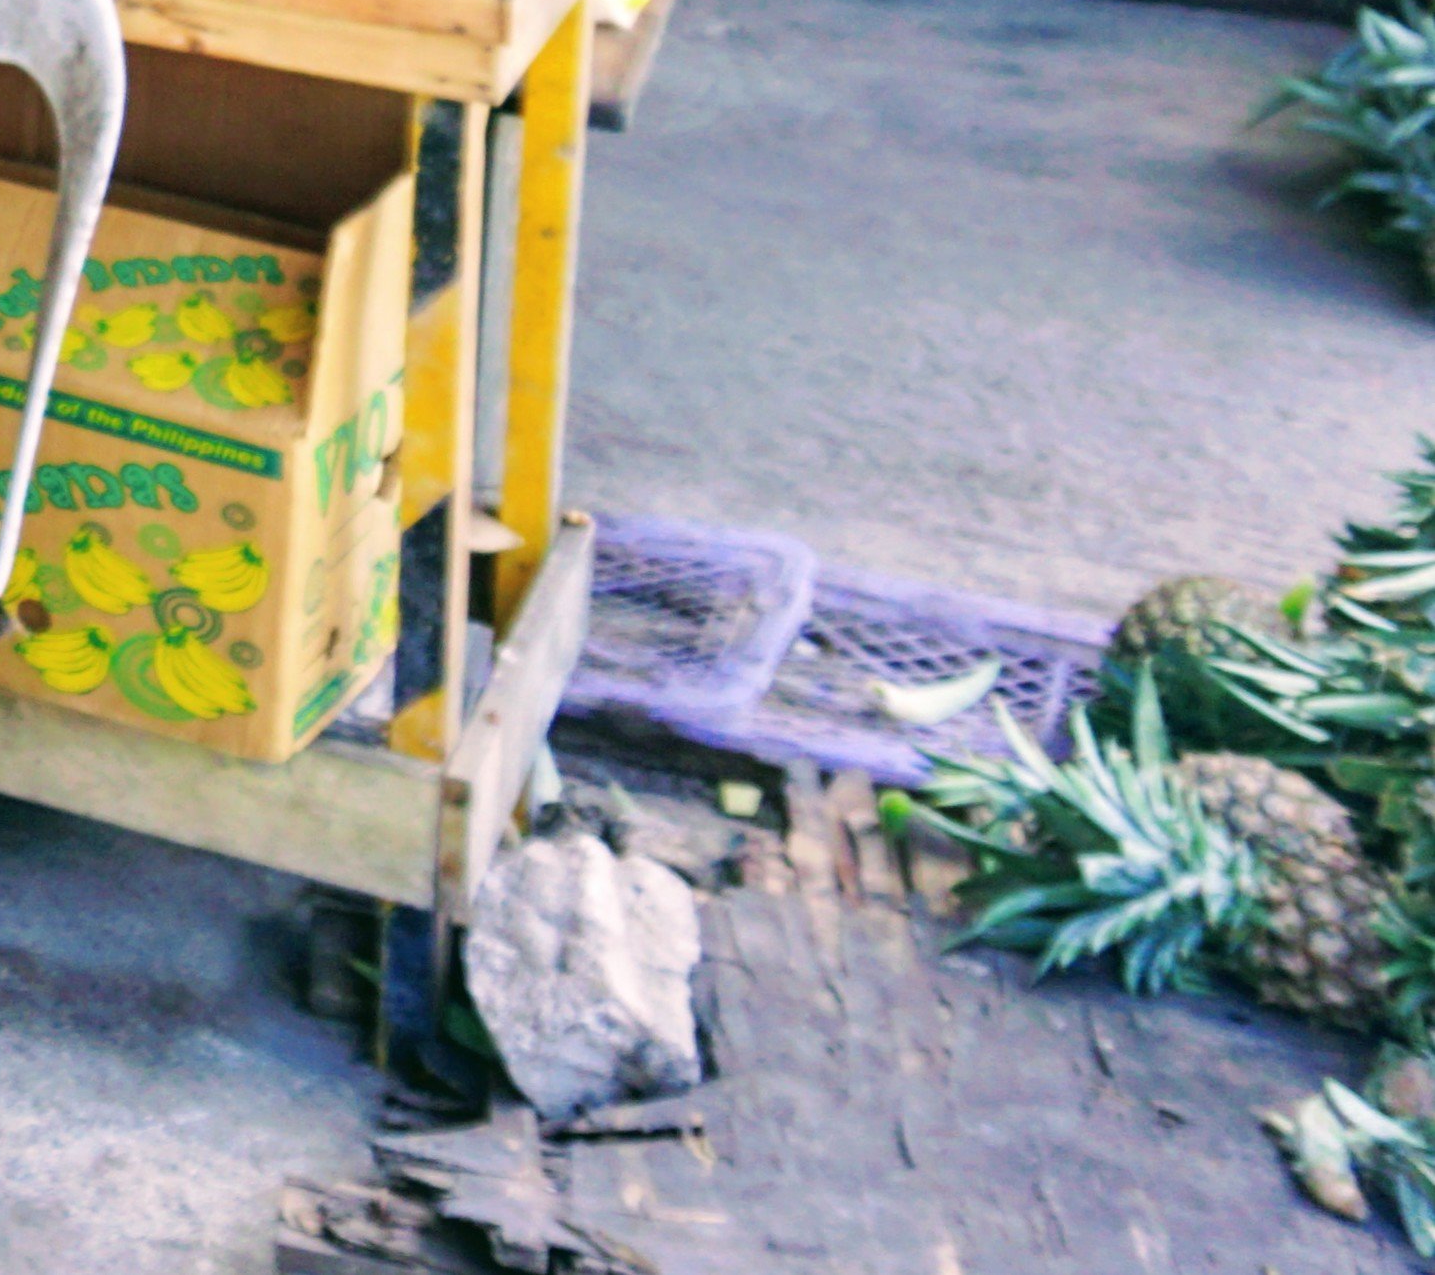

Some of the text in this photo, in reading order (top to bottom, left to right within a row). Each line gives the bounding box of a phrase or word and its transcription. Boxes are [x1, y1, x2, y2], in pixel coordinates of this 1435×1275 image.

[55, 399, 79, 416] of
[87, 407, 123, 431] the
[129, 415, 267, 470] Philippines
